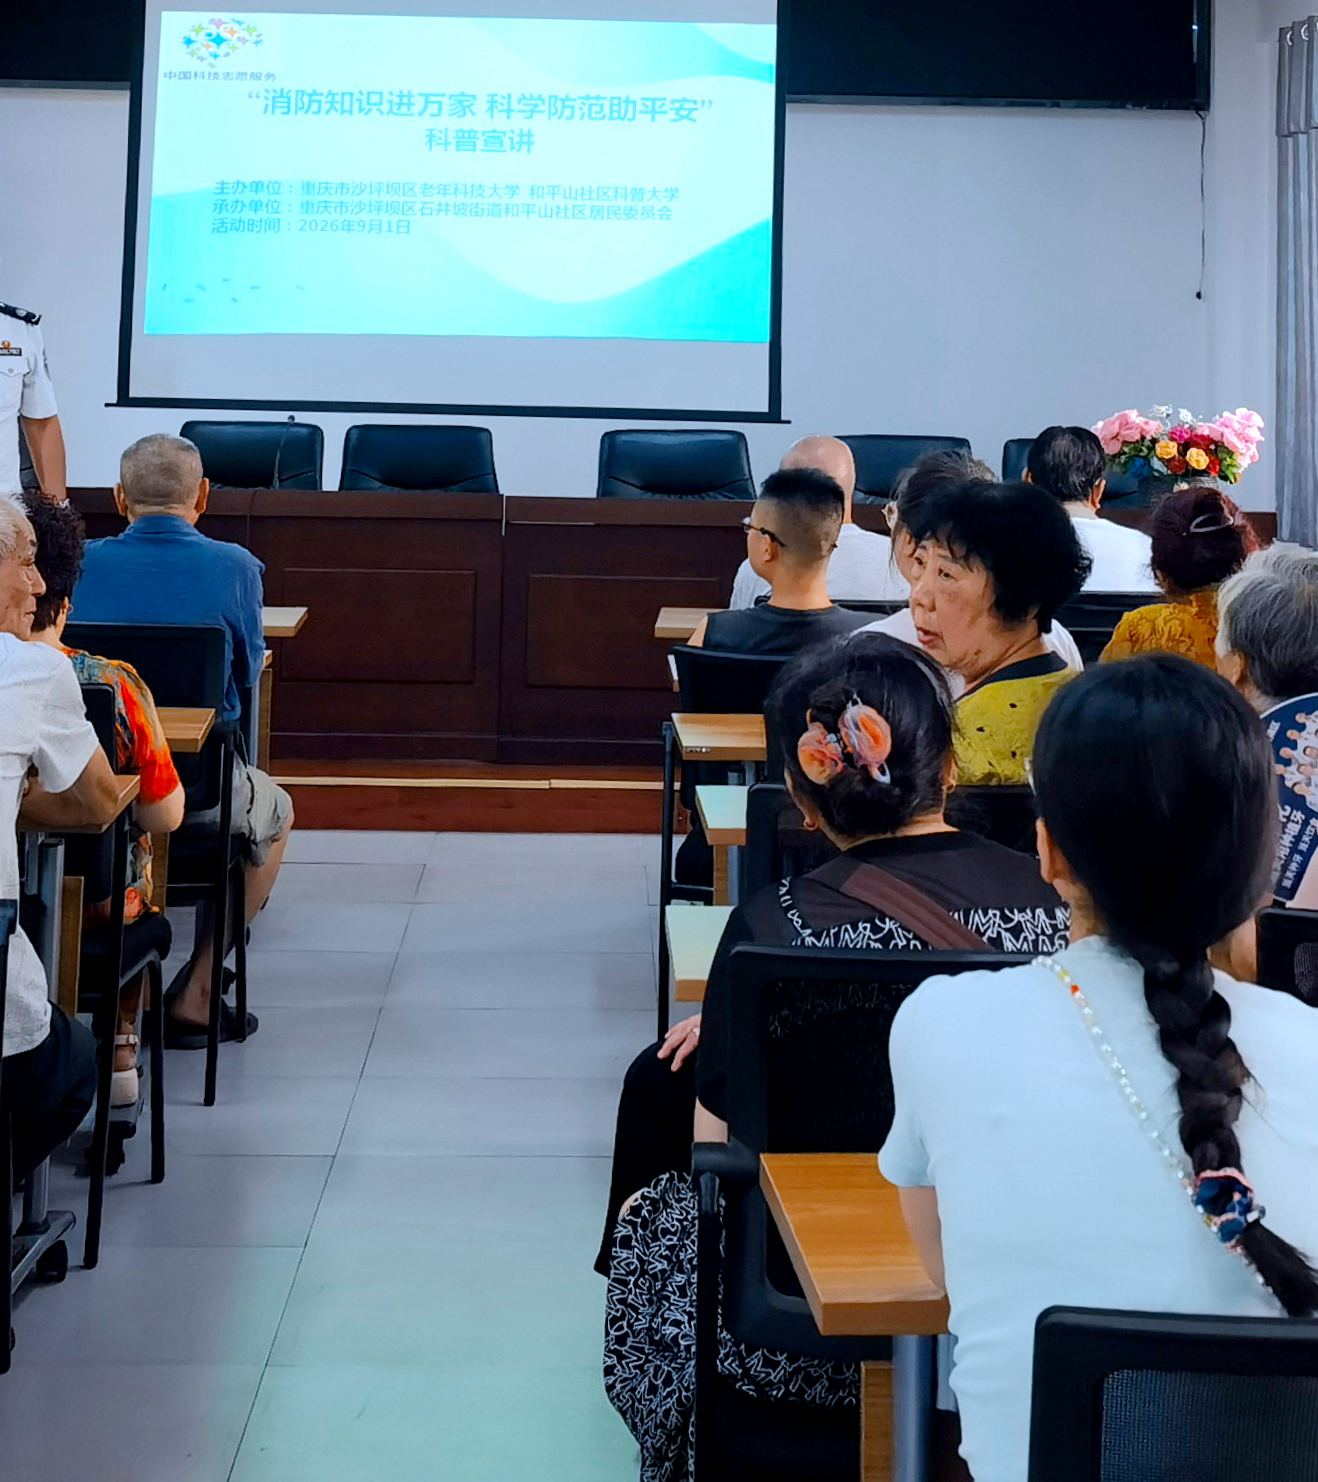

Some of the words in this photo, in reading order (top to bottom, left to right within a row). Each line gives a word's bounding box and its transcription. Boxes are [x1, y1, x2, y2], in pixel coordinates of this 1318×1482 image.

[163, 70, 277, 82] 中国科技志愿服务
[247, 87, 477, 119] “消防知识进万家
[485, 92, 713, 123] 科学防范助平安”
[424, 127, 535, 153] 科普宣讲
[529, 184, 680, 203] 和平山社区科普大学
